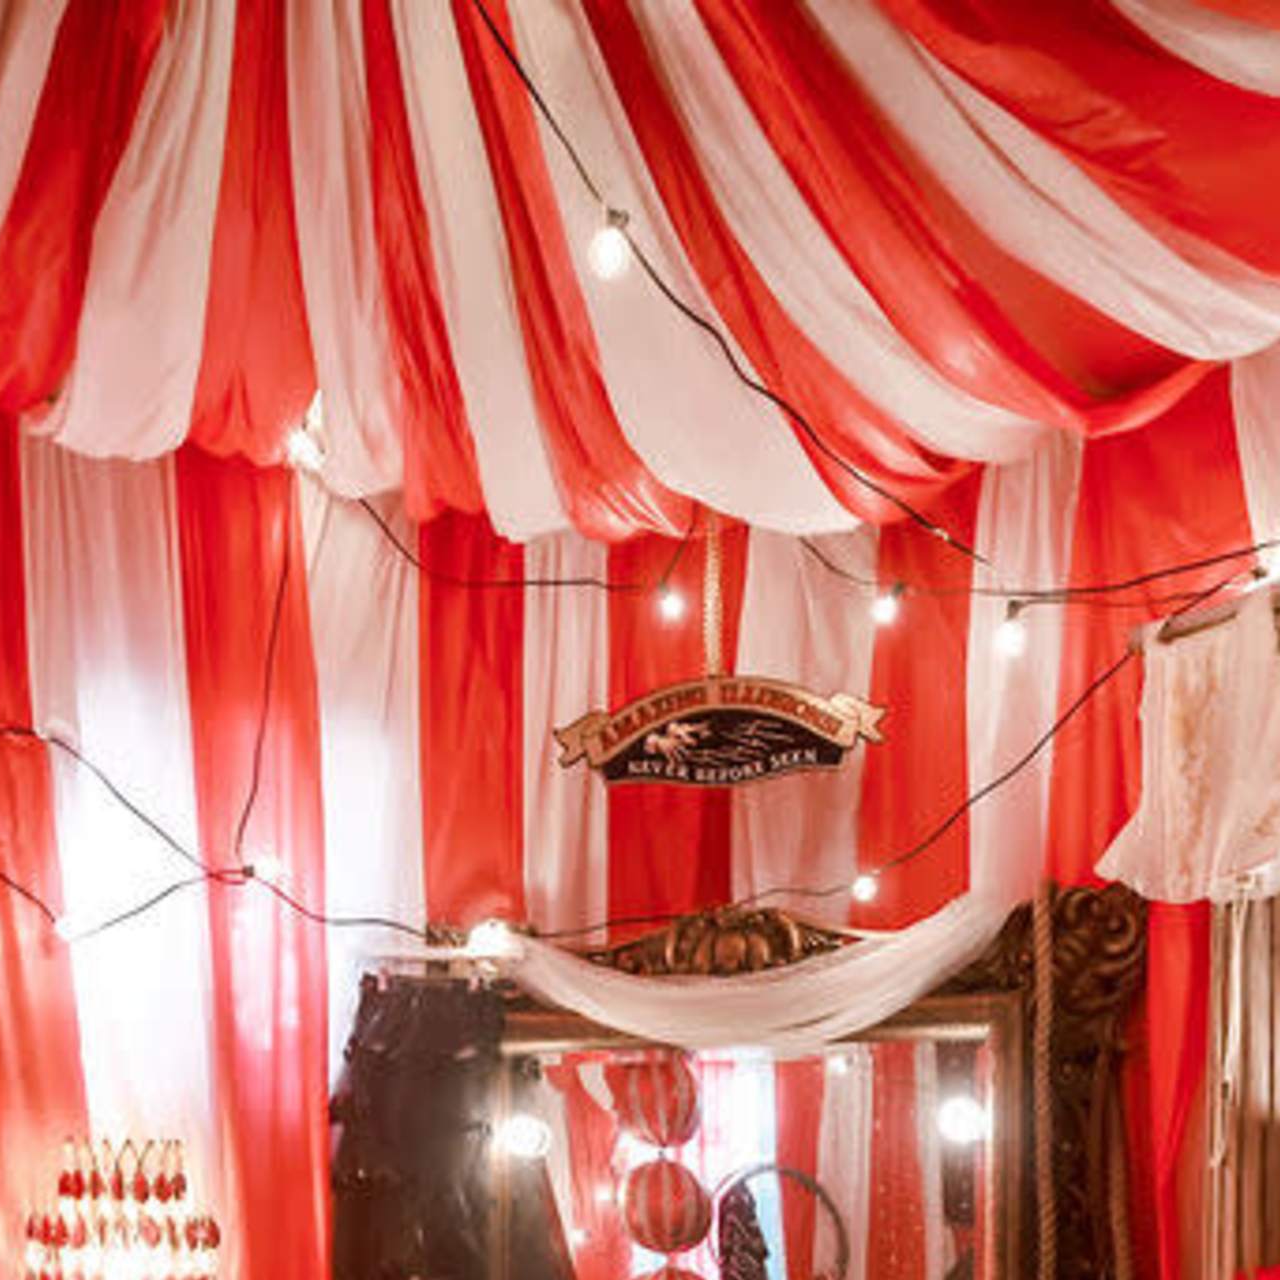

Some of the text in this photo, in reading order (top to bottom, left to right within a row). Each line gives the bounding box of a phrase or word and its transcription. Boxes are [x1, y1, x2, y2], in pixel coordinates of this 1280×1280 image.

[627, 748, 817, 782] NEVER BEFORE SEEN
